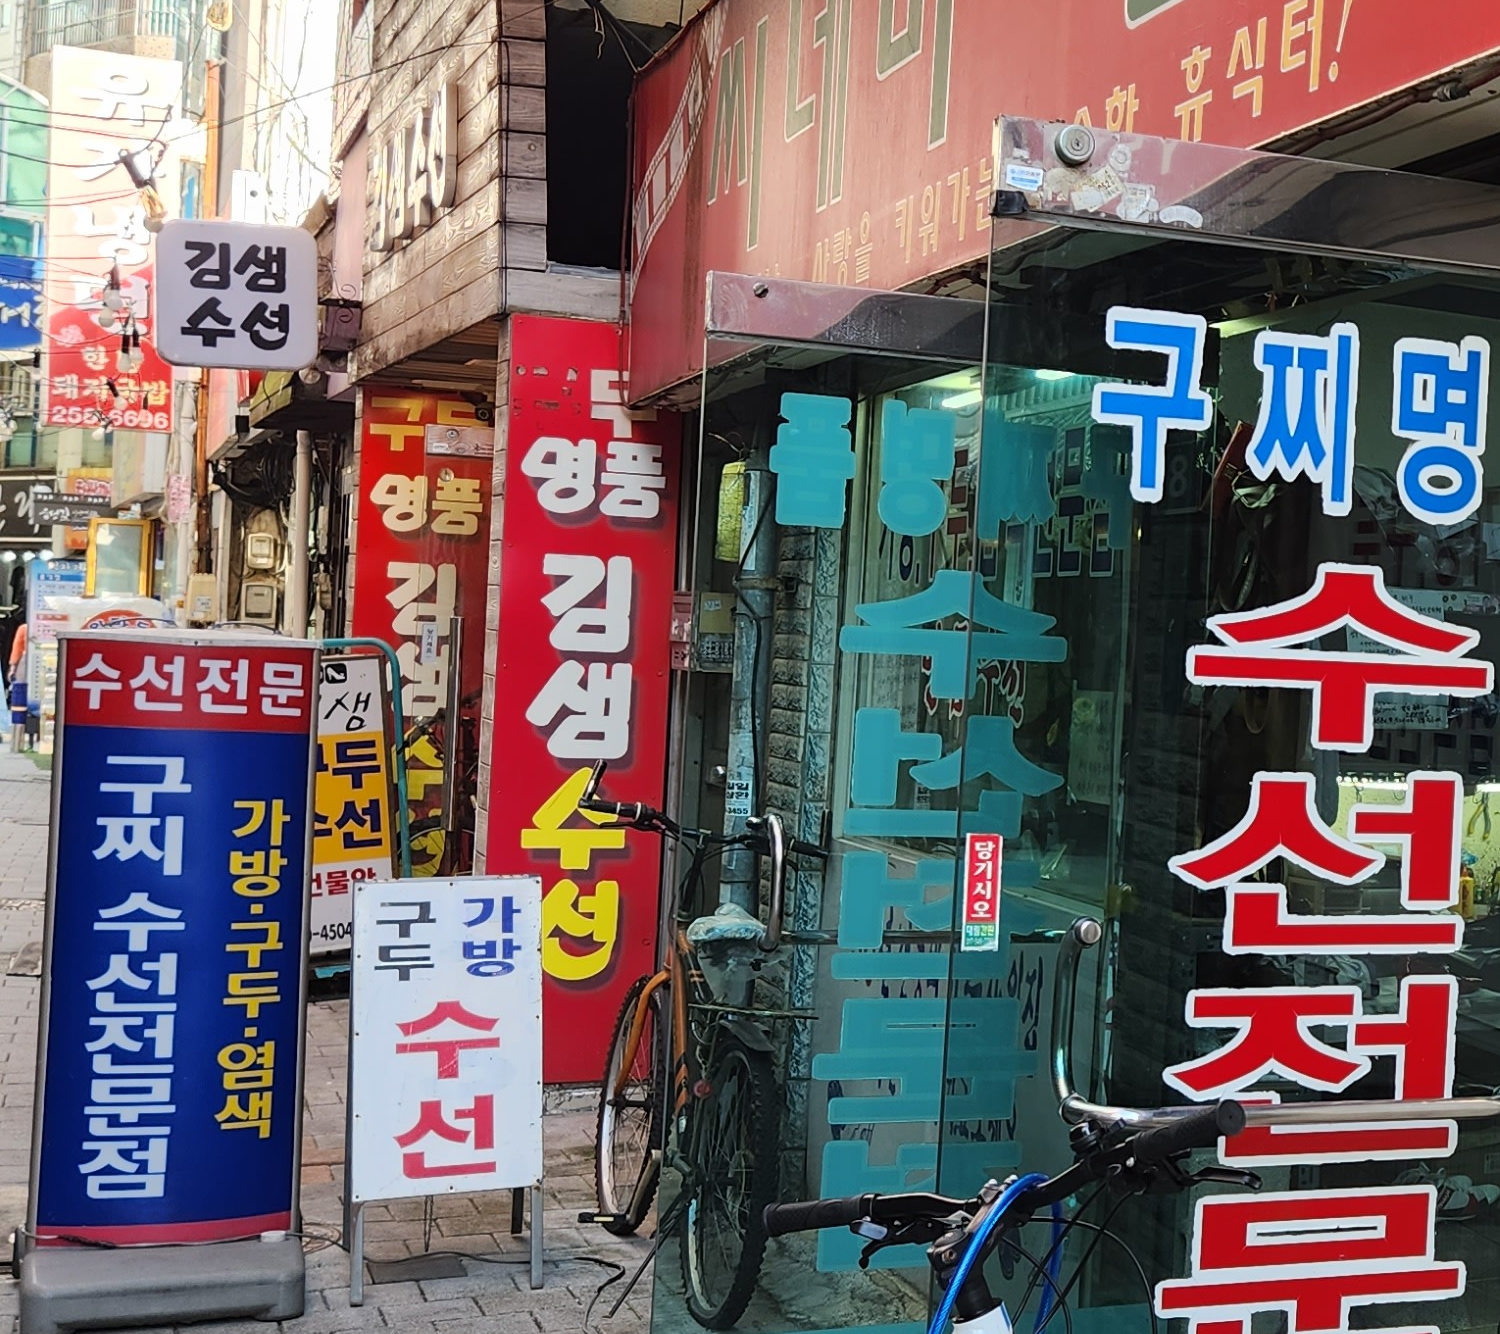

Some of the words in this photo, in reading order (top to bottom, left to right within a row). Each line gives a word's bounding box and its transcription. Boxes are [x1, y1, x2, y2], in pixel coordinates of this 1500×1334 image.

[183, 240, 288, 293] 김생
[180, 297, 290, 352] 수선
[521, 436, 667, 519] 명품
[71, 653, 307, 720] 수선전문
[526, 553, 634, 760] 김생
[93, 755, 192, 877] 구찌
[521, 765, 628, 981] 수선
[970, 840, 996, 918] 당기시오
[462, 897, 523, 978] 가방
[77, 893, 187, 1201] 수선전문점
[393, 999, 502, 1180] 수선
